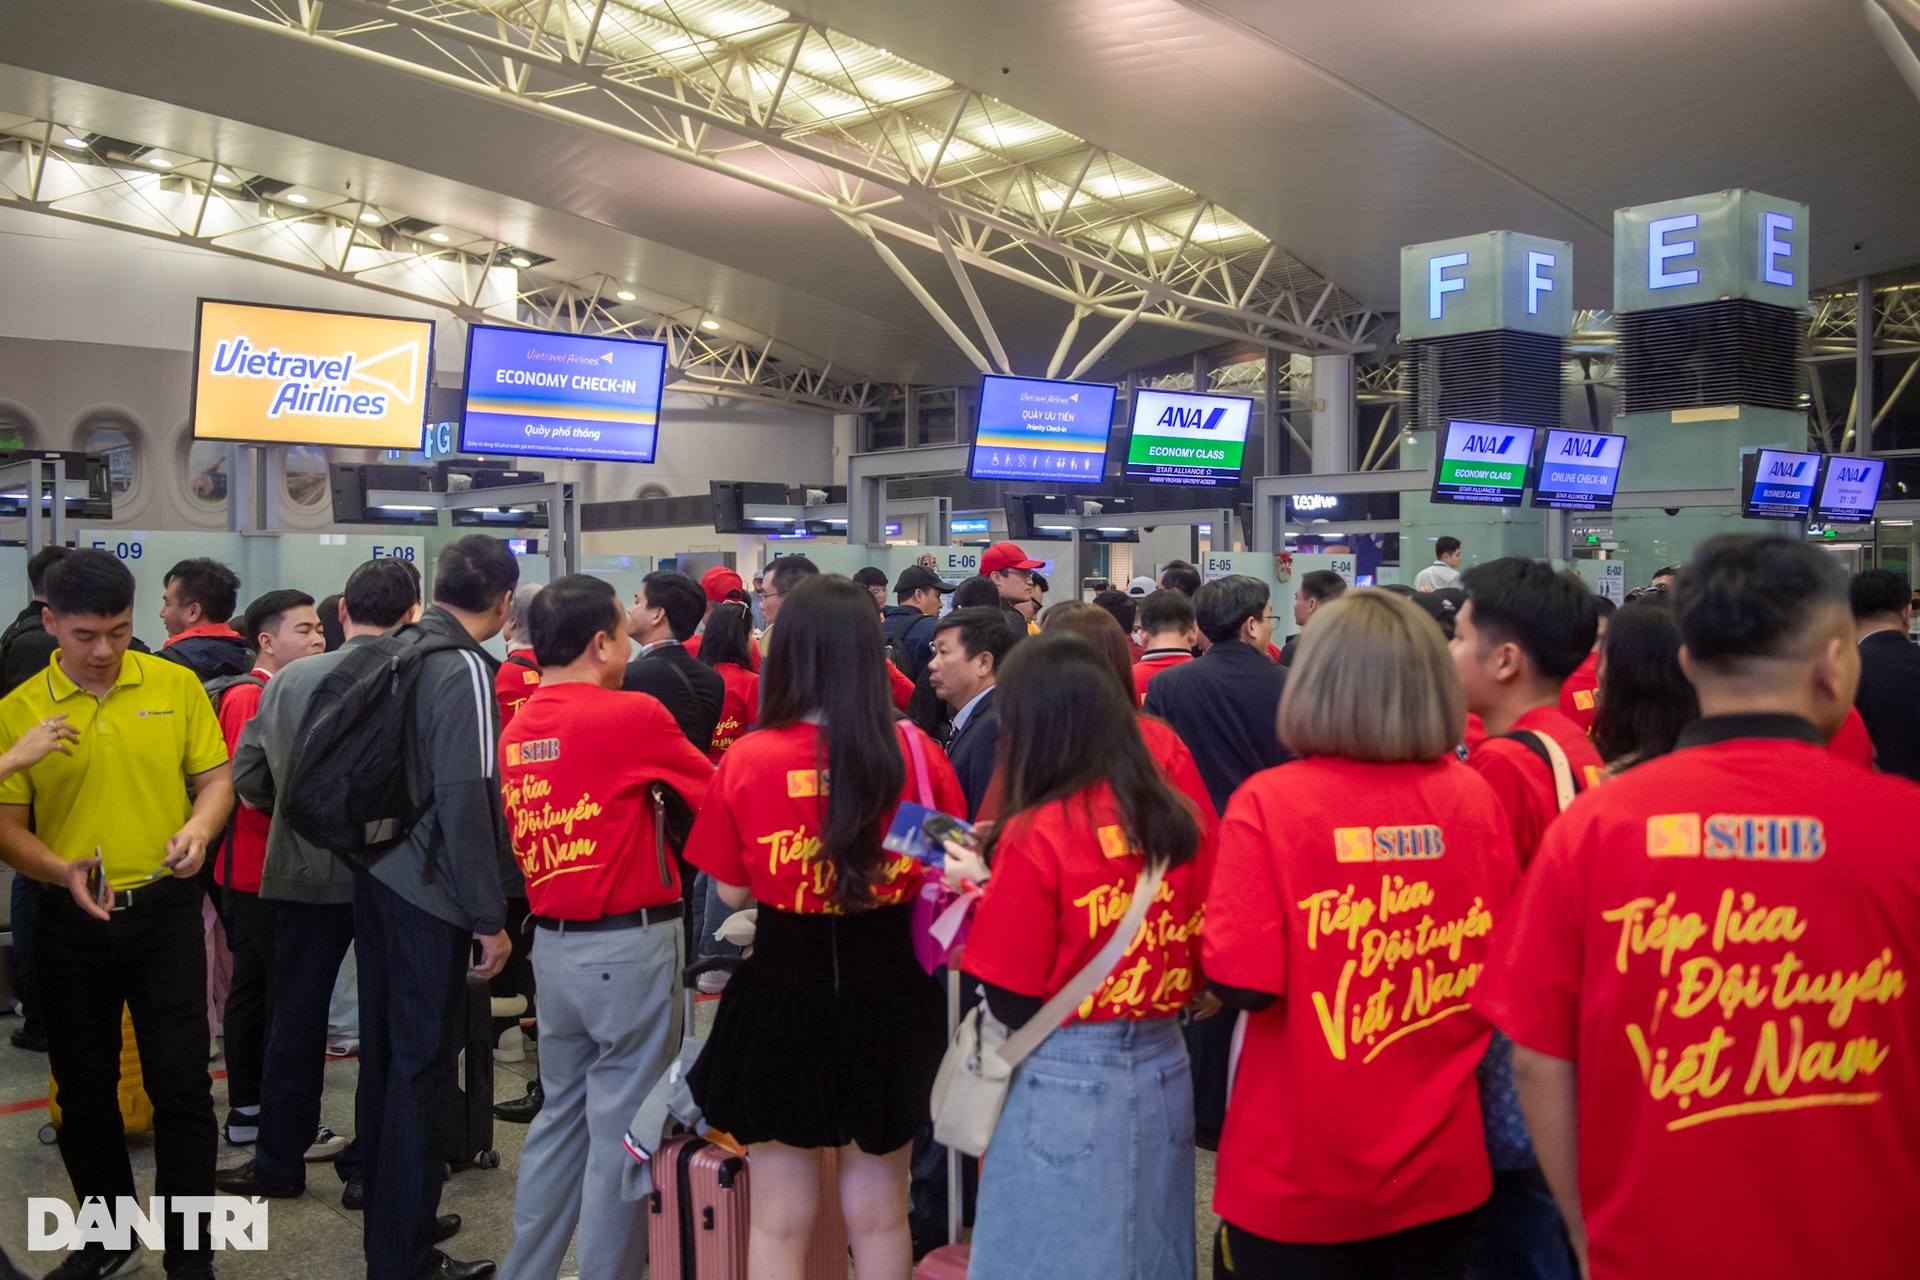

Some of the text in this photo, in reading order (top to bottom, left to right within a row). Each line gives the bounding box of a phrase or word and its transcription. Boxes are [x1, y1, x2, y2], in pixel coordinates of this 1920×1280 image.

[1649, 213, 1699, 290] E
[1764, 211, 1794, 287] E
[1429, 252, 1469, 320] F
[1526, 250, 1556, 315] F
[212, 336, 354, 382] Vietravel
[526, 348, 599, 367] Vietravel Airlines
[496, 369, 637, 395] ECONOMY CHECK-IN
[268, 382, 386, 417] Airlines
[1026, 423, 1045, 433] Priority
[1157, 407, 1202, 429] ANA
[524, 422, 601, 442] Quầy phổ thông
[1149, 446, 1225, 460] ECONOMY CLASS
[1462, 435, 1496, 454] ANA
[1560, 437, 1591, 457] ANA
[1156, 466, 1205, 475] STAR ALLIANCE
[1455, 469, 1511, 480] ECONOMY CLASS
[1551, 472, 1608, 485] ONLINE CHECK-IN
[1769, 462, 1793, 477] ANA
[1837, 467, 1860, 482] ANA
[1763, 489, 1801, 499] BUSINESS CLASS
[948, 554, 976, 568] E-06
[1209, 559, 1231, 571] E-05
[1331, 561, 1351, 572] E-04
[1606, 566, 1622, 575] E-02
[521, 739, 559, 764] SHB
[1374, 825, 1445, 862] SHB
[1703, 814, 1827, 863] SHB
[543, 833, 597, 870] Nam
[1298, 884, 1376, 950] Tiếp
[1358, 896, 1493, 978] Đội tuyển
[1601, 890, 1709, 977] Tiếp
[1671, 946, 1907, 1029] Đội tuyển
[1311, 958, 1485, 1061] Việt Nam
[1624, 987, 1892, 1111] Việt Nam
